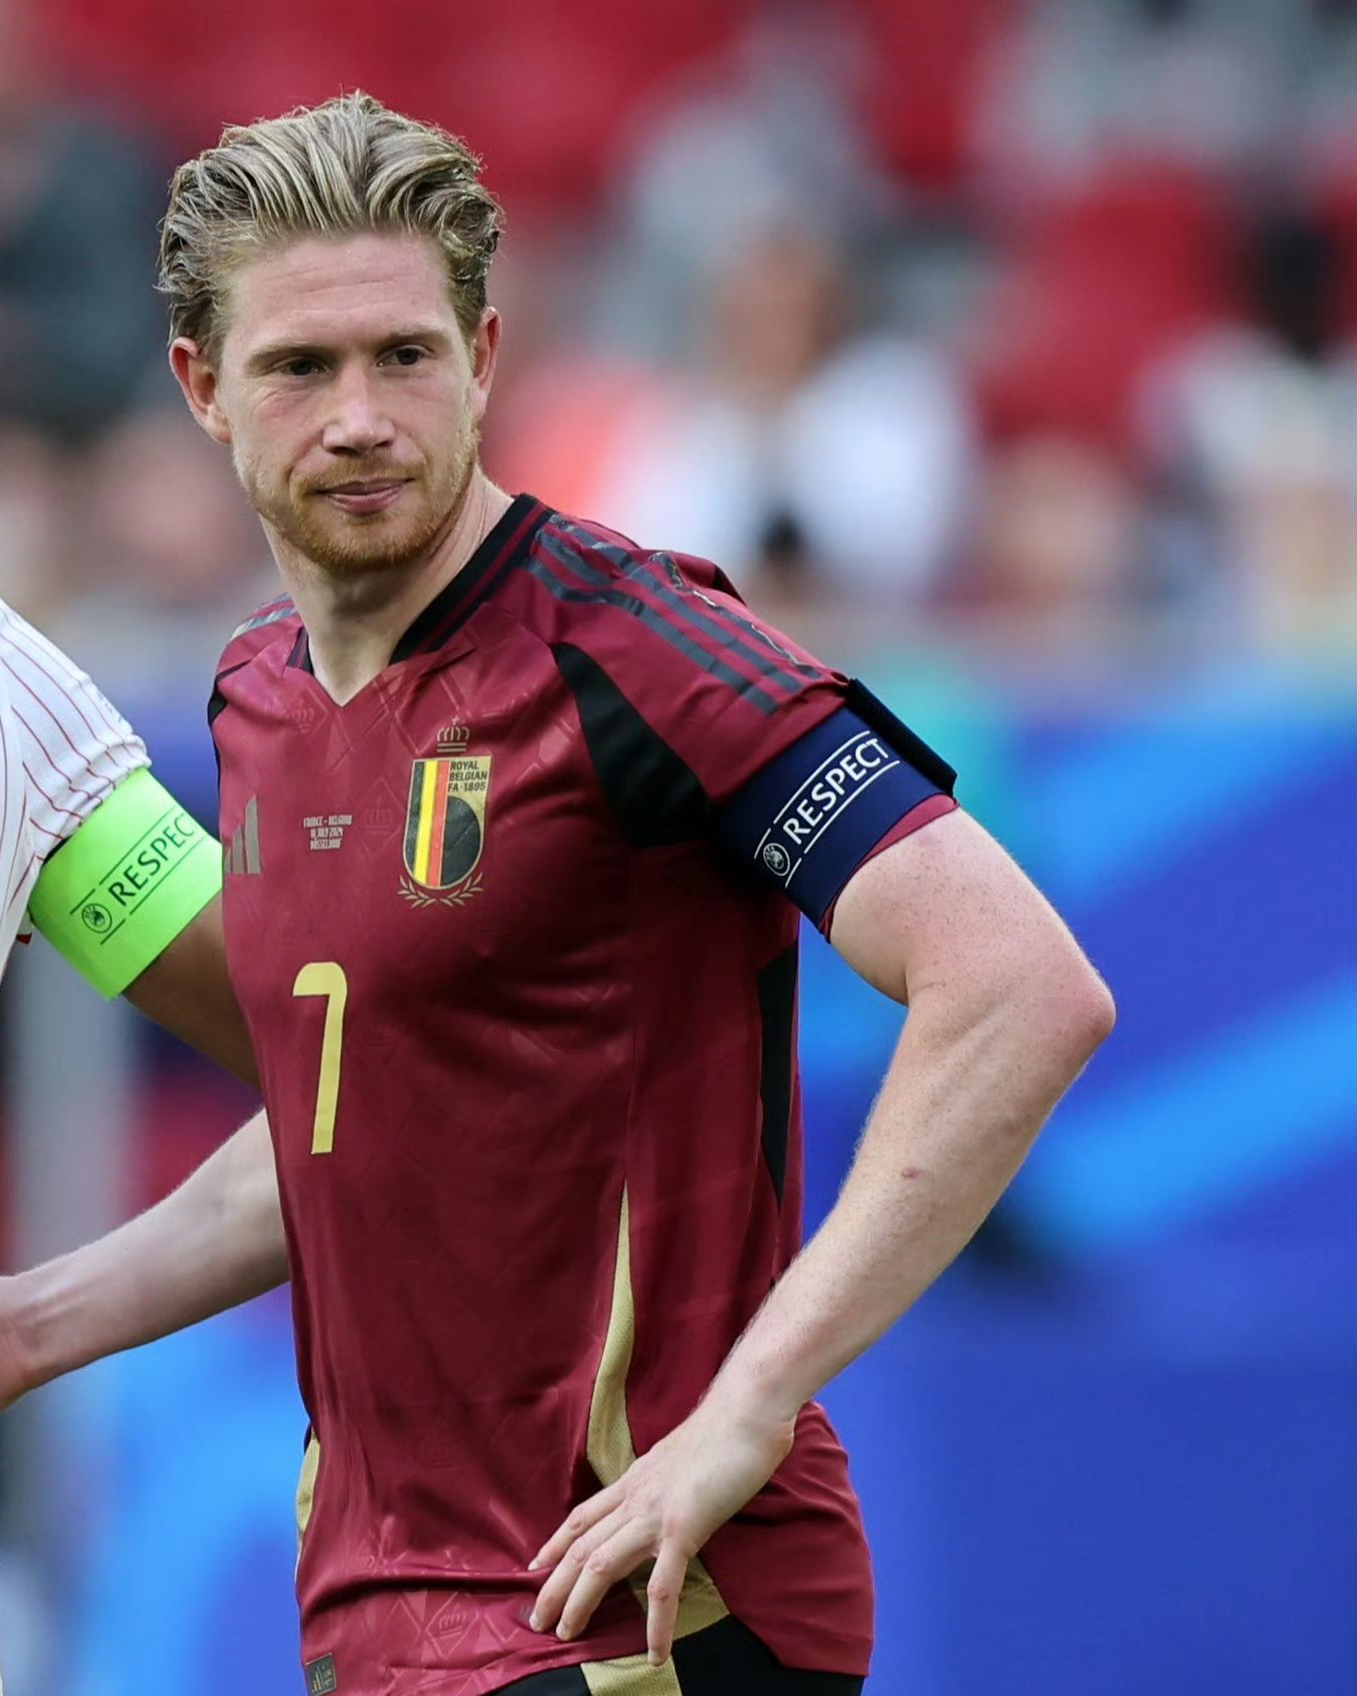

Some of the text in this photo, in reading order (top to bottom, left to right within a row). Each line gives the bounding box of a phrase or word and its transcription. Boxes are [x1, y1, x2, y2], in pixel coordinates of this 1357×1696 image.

[449, 771, 488, 781] BELGIAN
[450, 760, 479, 771] ROYAL
[782, 738, 890, 846] RESPECT
[108, 812, 195, 907] RESPEC
[292, 961, 348, 1155] 7
